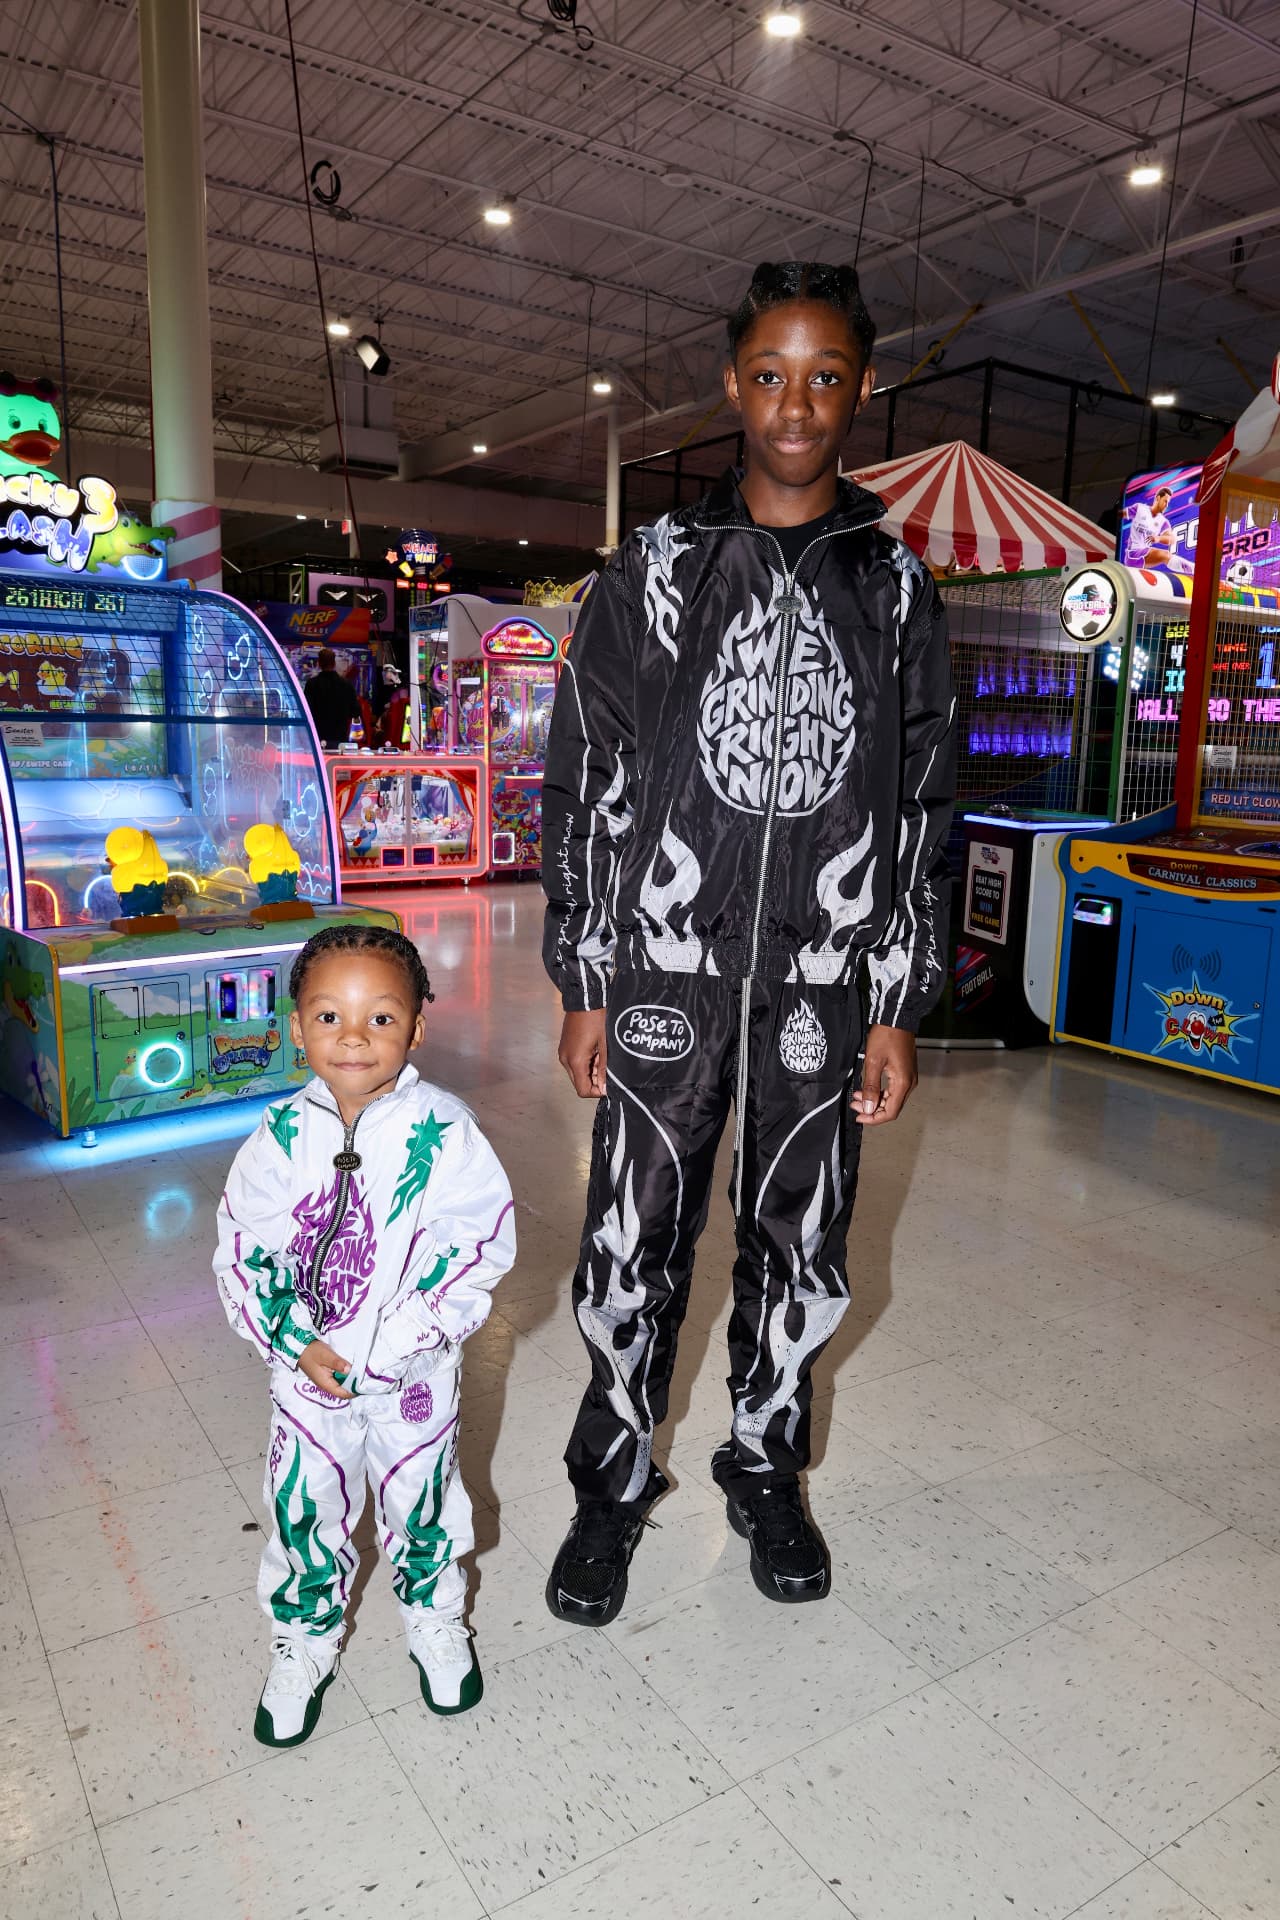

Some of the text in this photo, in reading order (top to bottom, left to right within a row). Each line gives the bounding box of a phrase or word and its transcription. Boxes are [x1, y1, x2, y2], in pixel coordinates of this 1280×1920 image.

[0, 472, 118, 533] cky 3
[0, 509, 93, 572] ASH
[402, 543, 438, 554] WHACK
[1222, 530, 1270, 556] PRO
[289, 610, 336, 627] NERF
[737, 616, 824, 681] WE
[702, 669, 856, 739] GRINDING
[714, 713, 844, 778] RIGHT
[727, 759, 827, 810] NOW
[1211, 793, 1231, 804] RED
[1233, 796, 1250, 806] LIT
[562, 812, 575, 843] now
[557, 847, 579, 895] right
[1170, 861, 1198, 870] Down
[976, 875, 1002, 888] BEAT HIGH
[1148, 866, 1200, 885] CARNIVAL
[1206, 877, 1257, 889] CLASSICS
[976, 886, 1000, 900] SCORE TO
[979, 901, 993, 913] WIN
[558, 897, 578, 946] grind
[971, 912, 1000, 928] FREE GAME
[961, 966, 994, 998] FOOTBALL
[1171, 991, 1224, 1010] Down
[791, 1016, 814, 1033] WE
[781, 1030, 827, 1047] GRINDING
[786, 1044, 823, 1060] RIGHT
[789, 1057, 819, 1071] NOW
